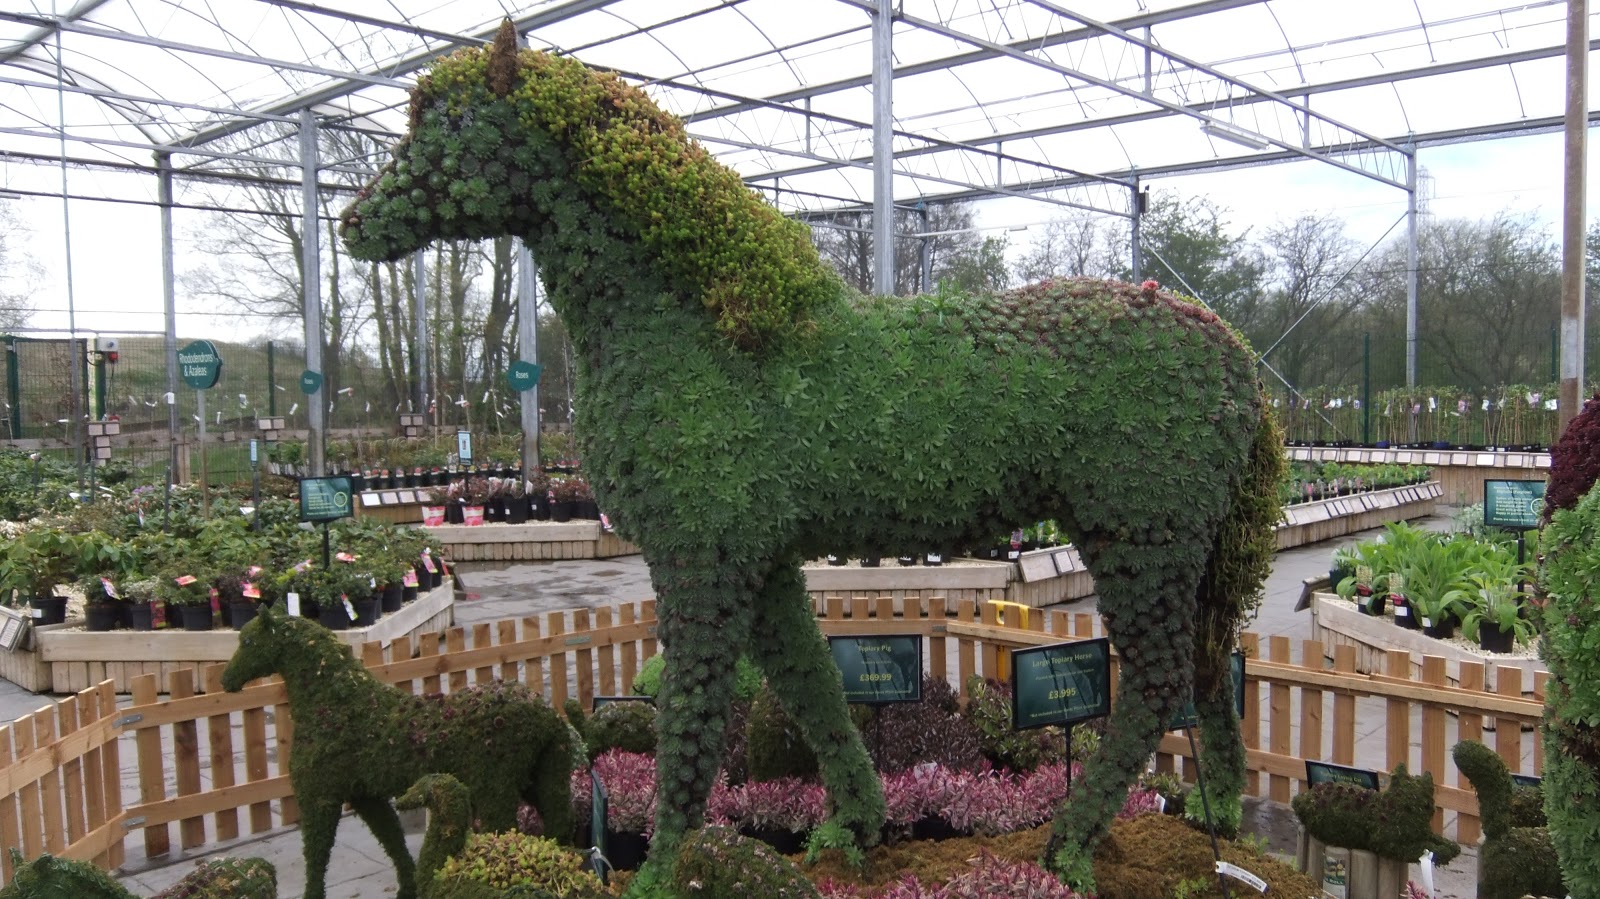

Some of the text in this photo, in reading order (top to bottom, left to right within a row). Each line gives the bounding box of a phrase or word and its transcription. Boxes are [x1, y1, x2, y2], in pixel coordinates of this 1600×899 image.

[859, 645, 880, 653] Topiary
[1033, 653, 1093, 667] Large Topiary Horse
[860, 673, 892, 682] £369.99
